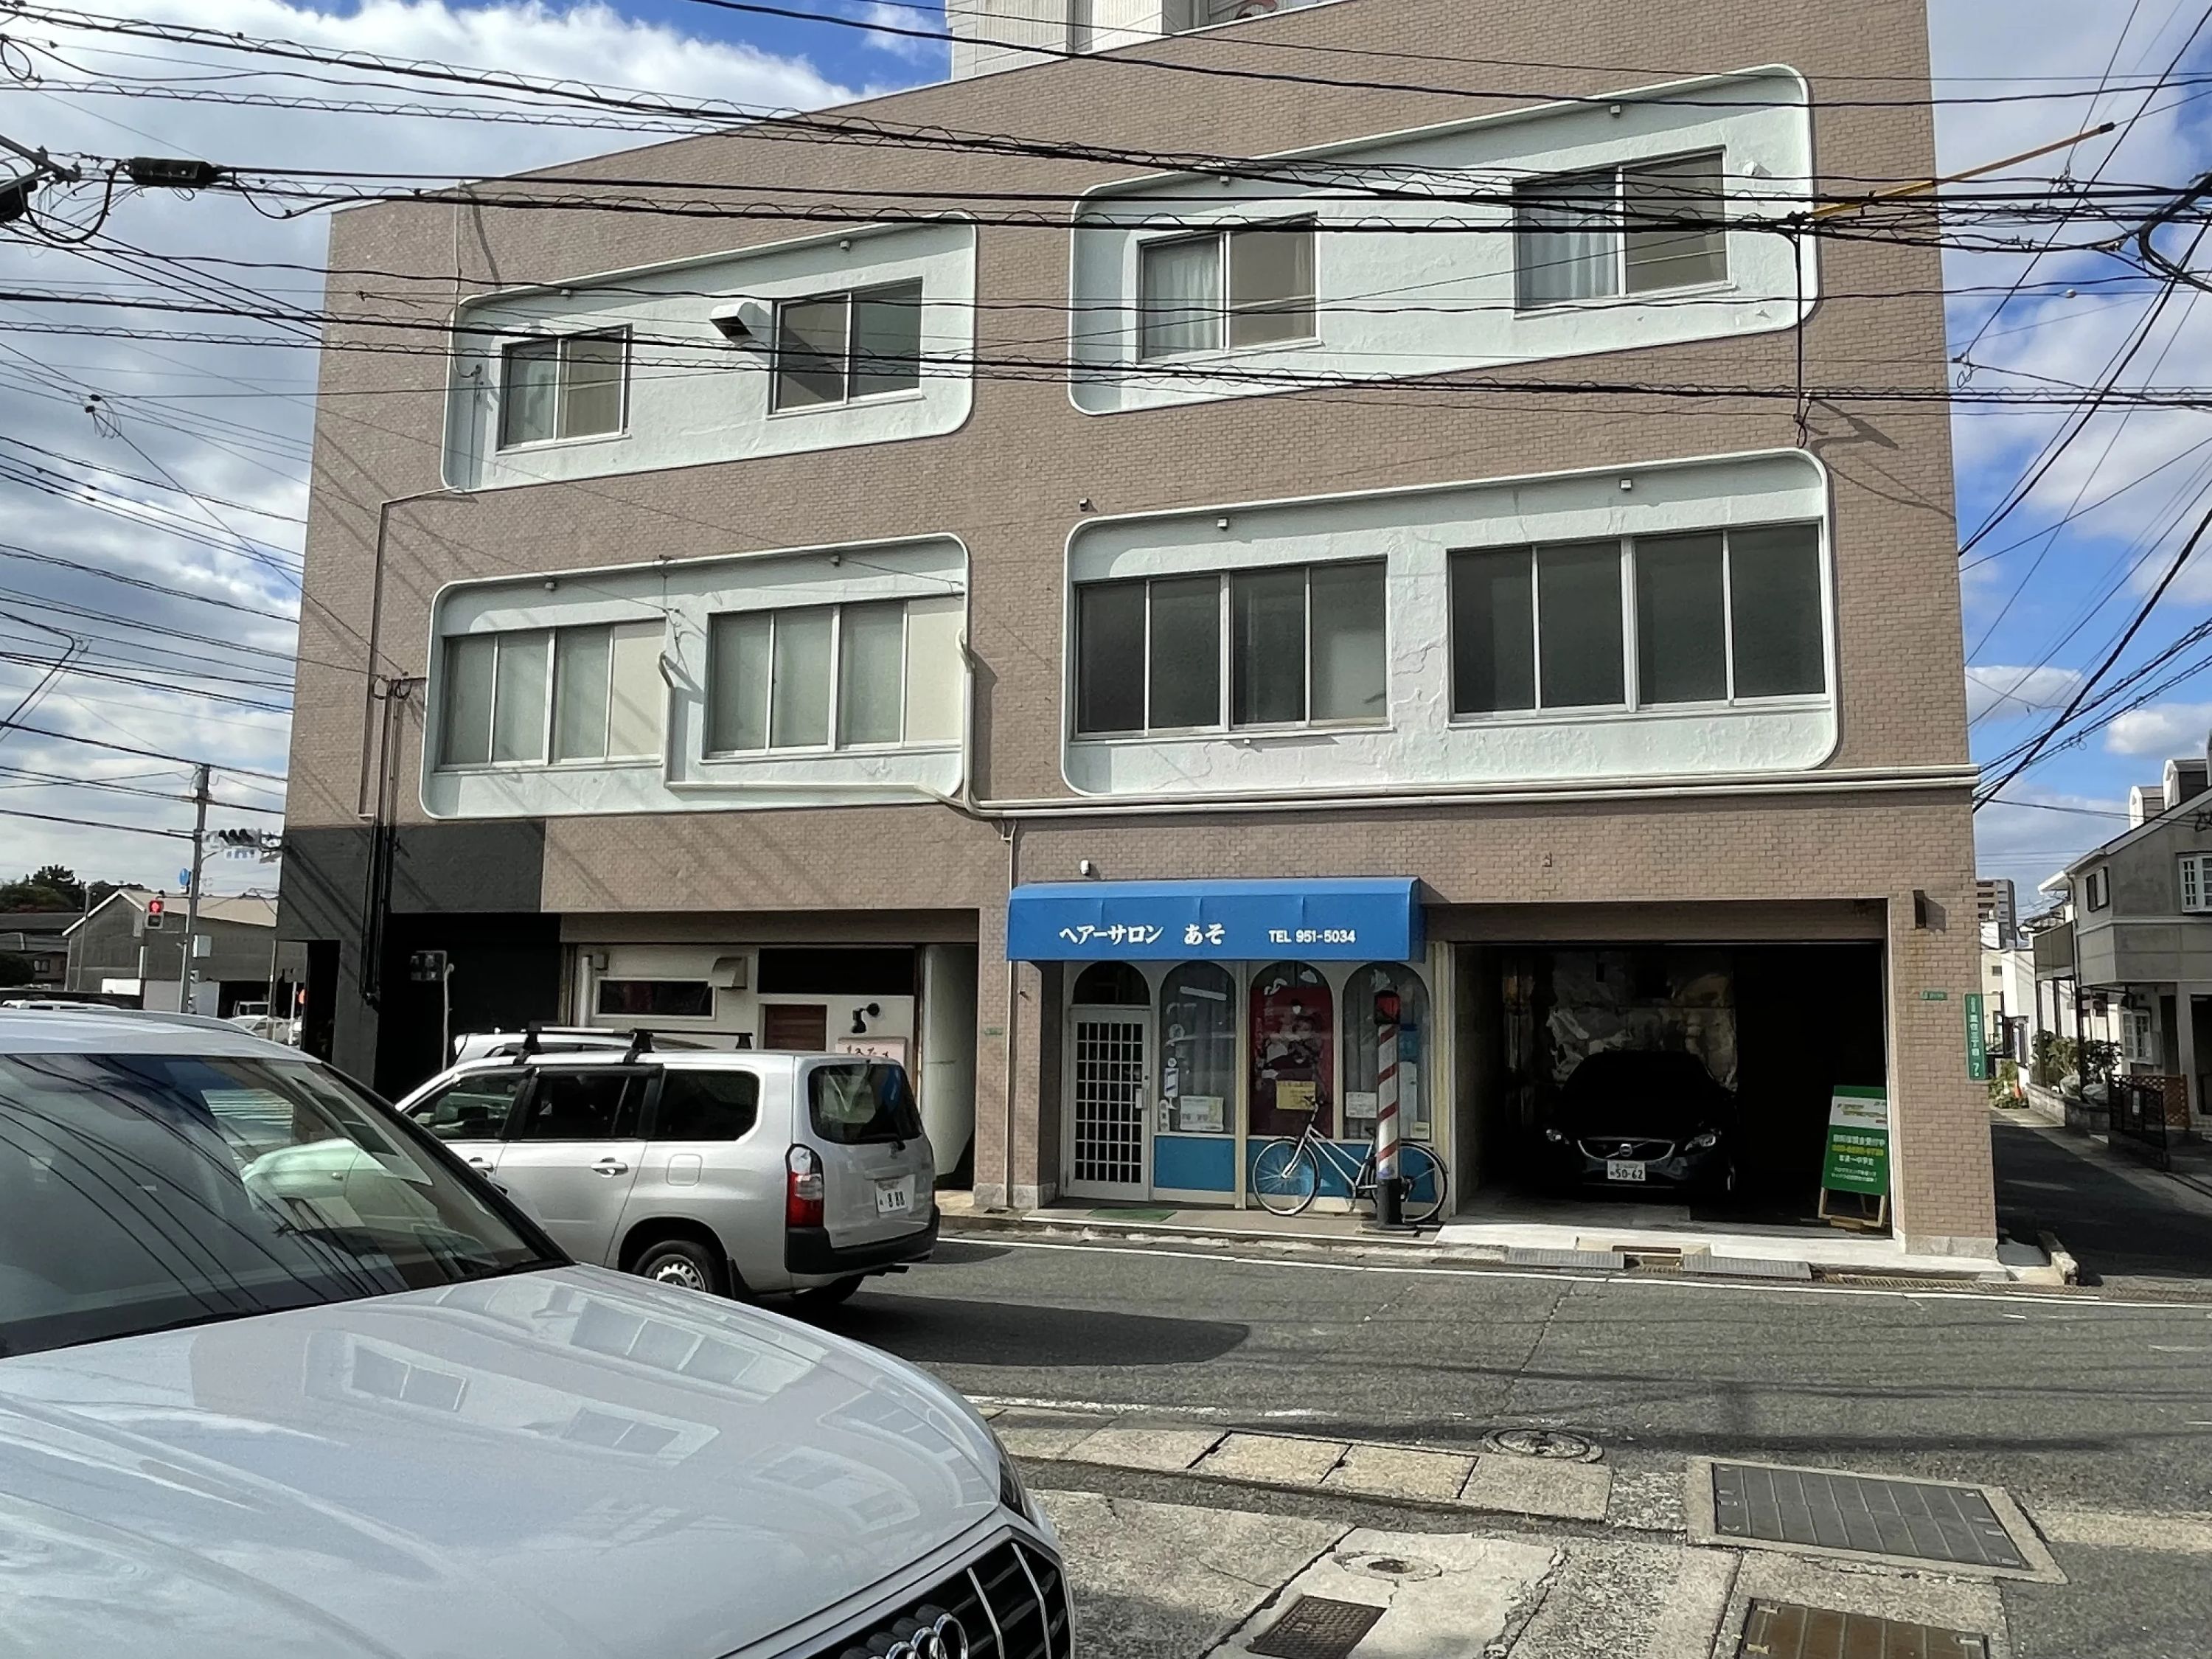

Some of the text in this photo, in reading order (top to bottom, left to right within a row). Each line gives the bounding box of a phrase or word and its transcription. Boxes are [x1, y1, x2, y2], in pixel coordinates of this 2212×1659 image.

[1059, 923, 1356, 945] ヘアーサロン あそ TEL 951-5034
[1615, 1169, 1644, 1180] 50-62
